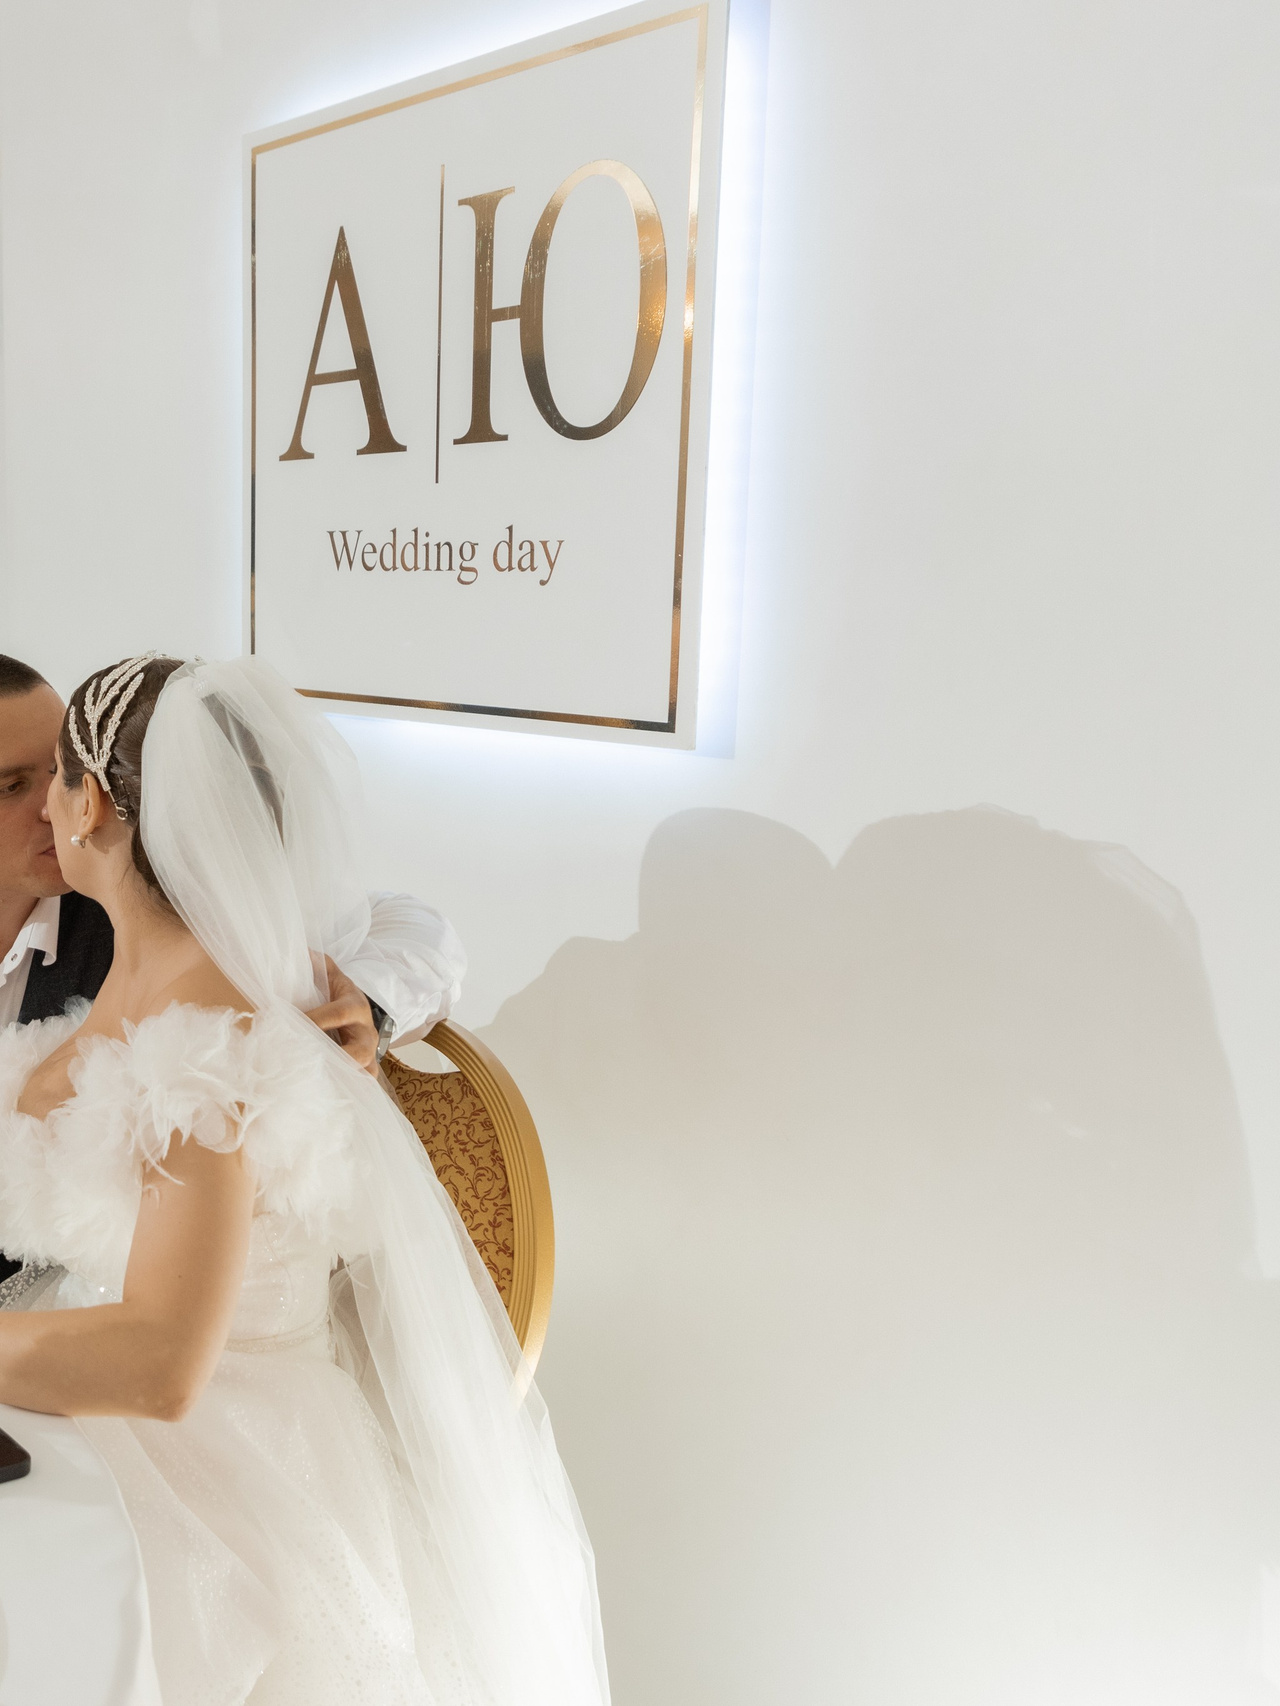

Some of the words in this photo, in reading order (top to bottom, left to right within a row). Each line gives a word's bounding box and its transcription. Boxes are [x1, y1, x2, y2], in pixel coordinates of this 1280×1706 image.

[453, 158, 668, 446] Ю
[326, 526, 480, 586] Wedding
[492, 524, 565, 587] day
